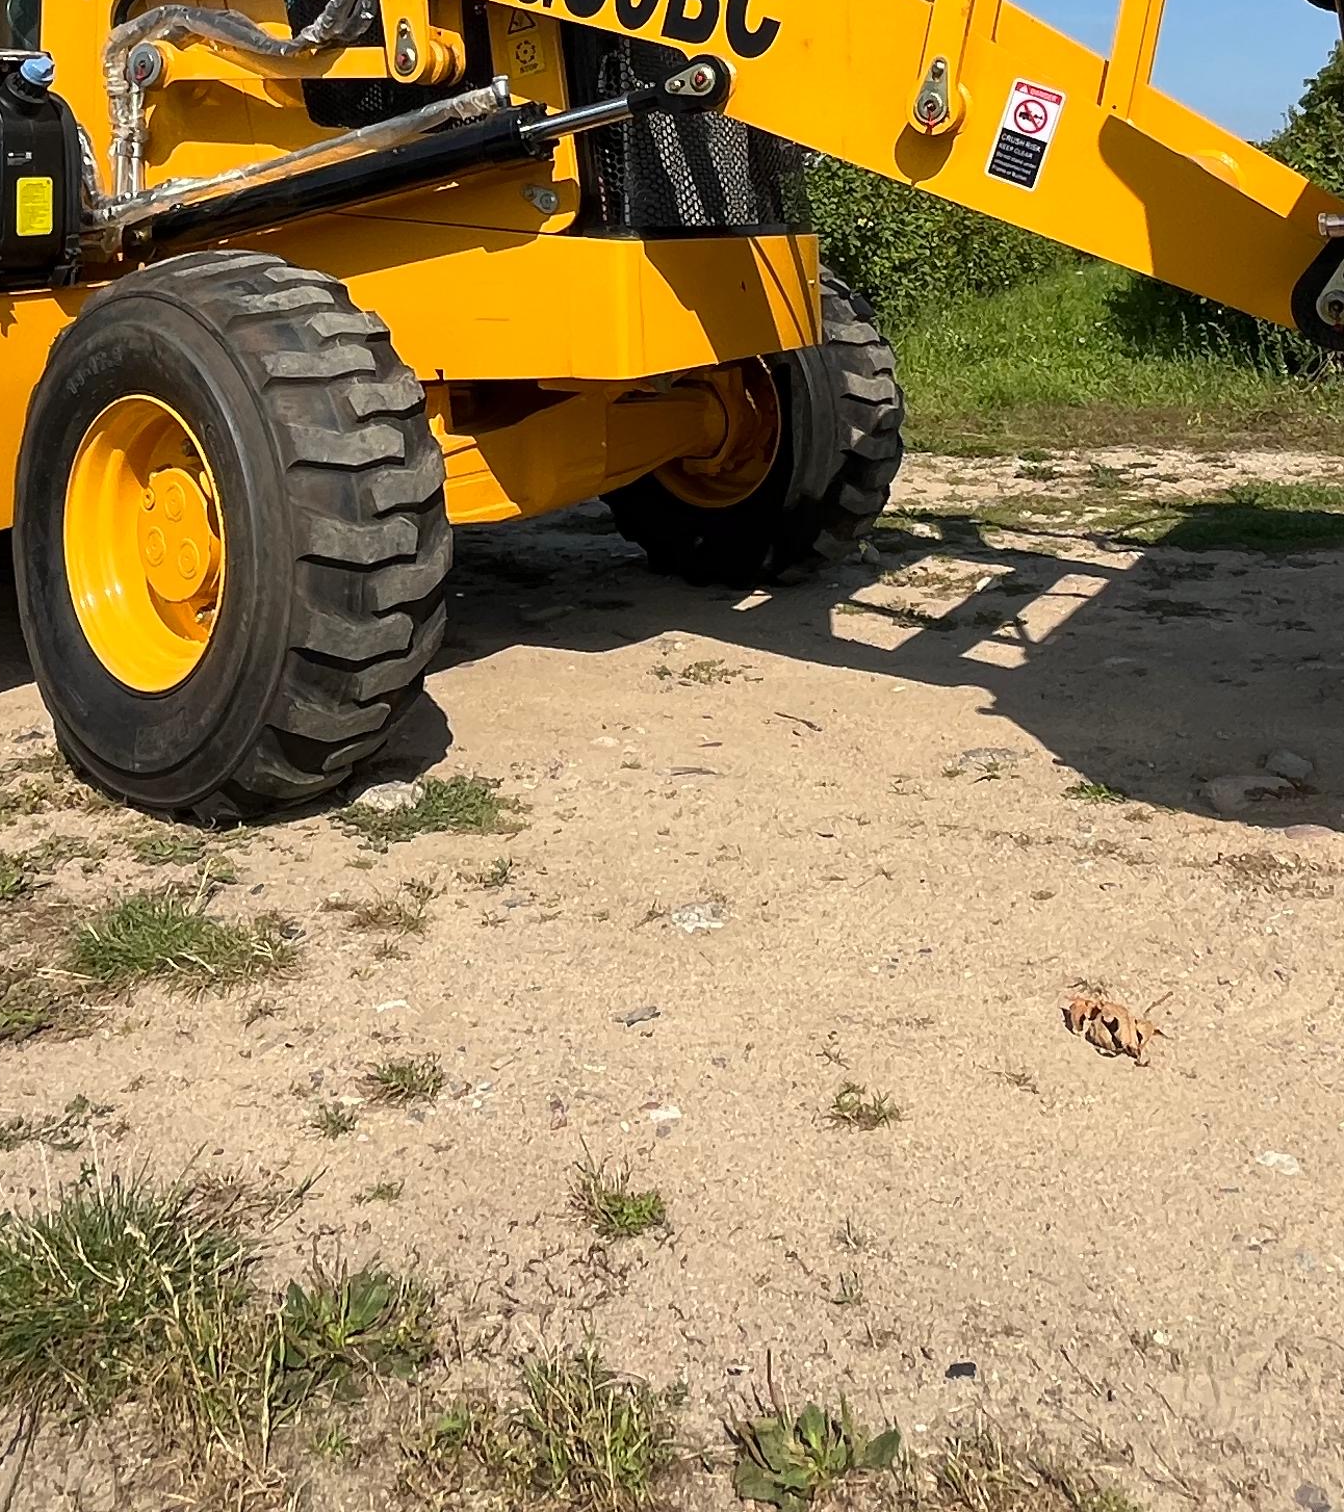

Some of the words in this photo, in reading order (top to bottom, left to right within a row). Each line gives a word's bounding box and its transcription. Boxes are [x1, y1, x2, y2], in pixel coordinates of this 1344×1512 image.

[998, 142, 1014, 152] KEEP
[1014, 147, 1033, 159] CLEAR
[1001, 133, 1025, 146] CRUSH
[1025, 141, 1041, 153] RISK
